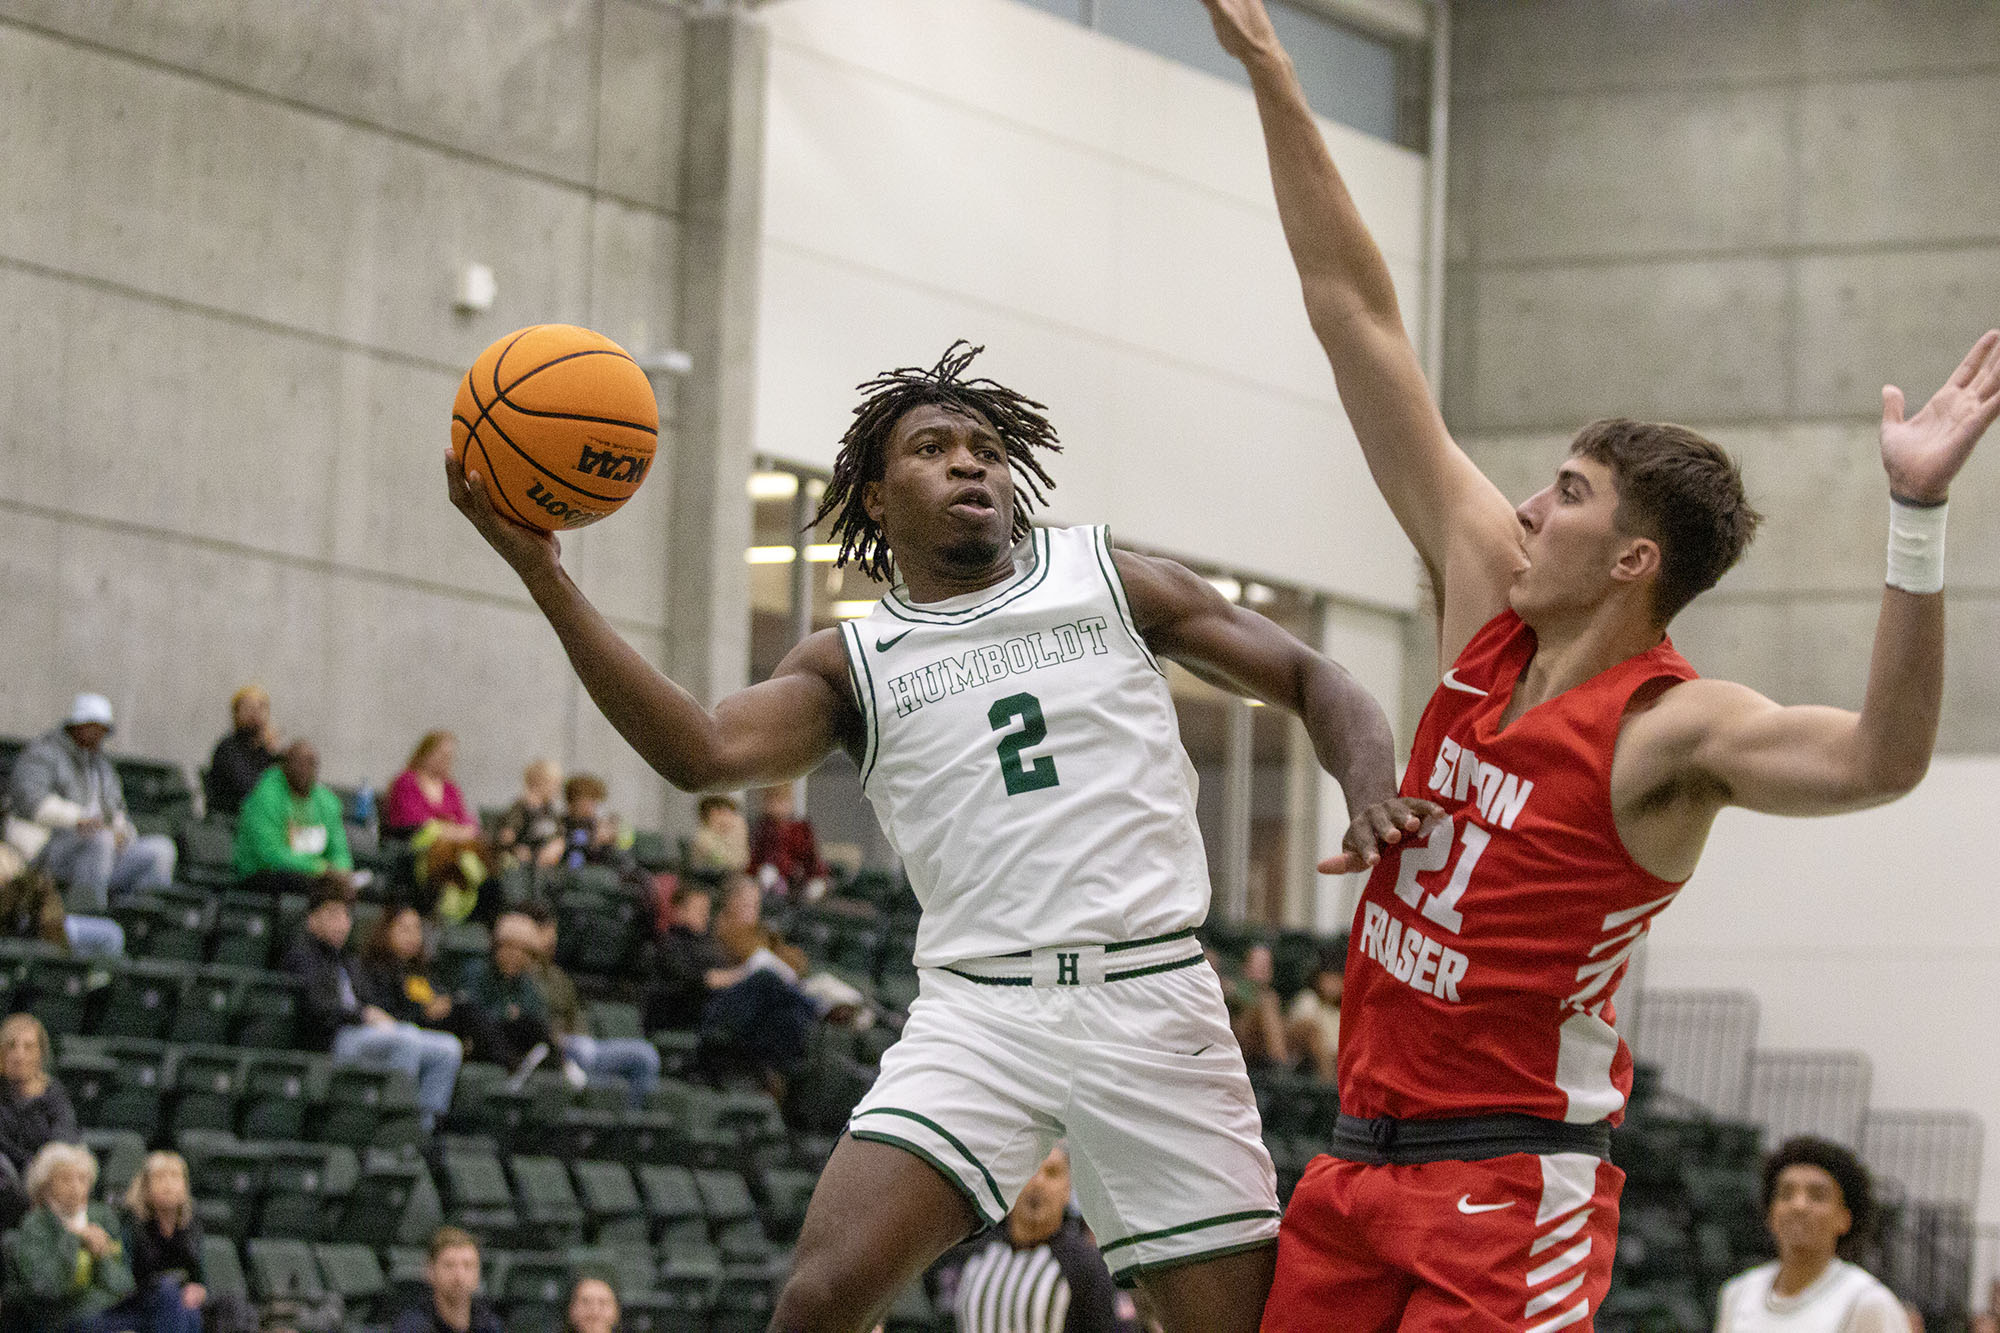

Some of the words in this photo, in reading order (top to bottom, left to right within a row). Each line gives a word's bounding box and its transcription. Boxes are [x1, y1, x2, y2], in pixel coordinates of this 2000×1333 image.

[577, 445, 650, 483] NCAA
[888, 616, 1108, 718] HUMBOLDT
[987, 692, 1060, 796] 2
[1394, 815, 1491, 935] 21
[1057, 953, 1080, 985] H
[1360, 900, 1469, 1001] FRASER
